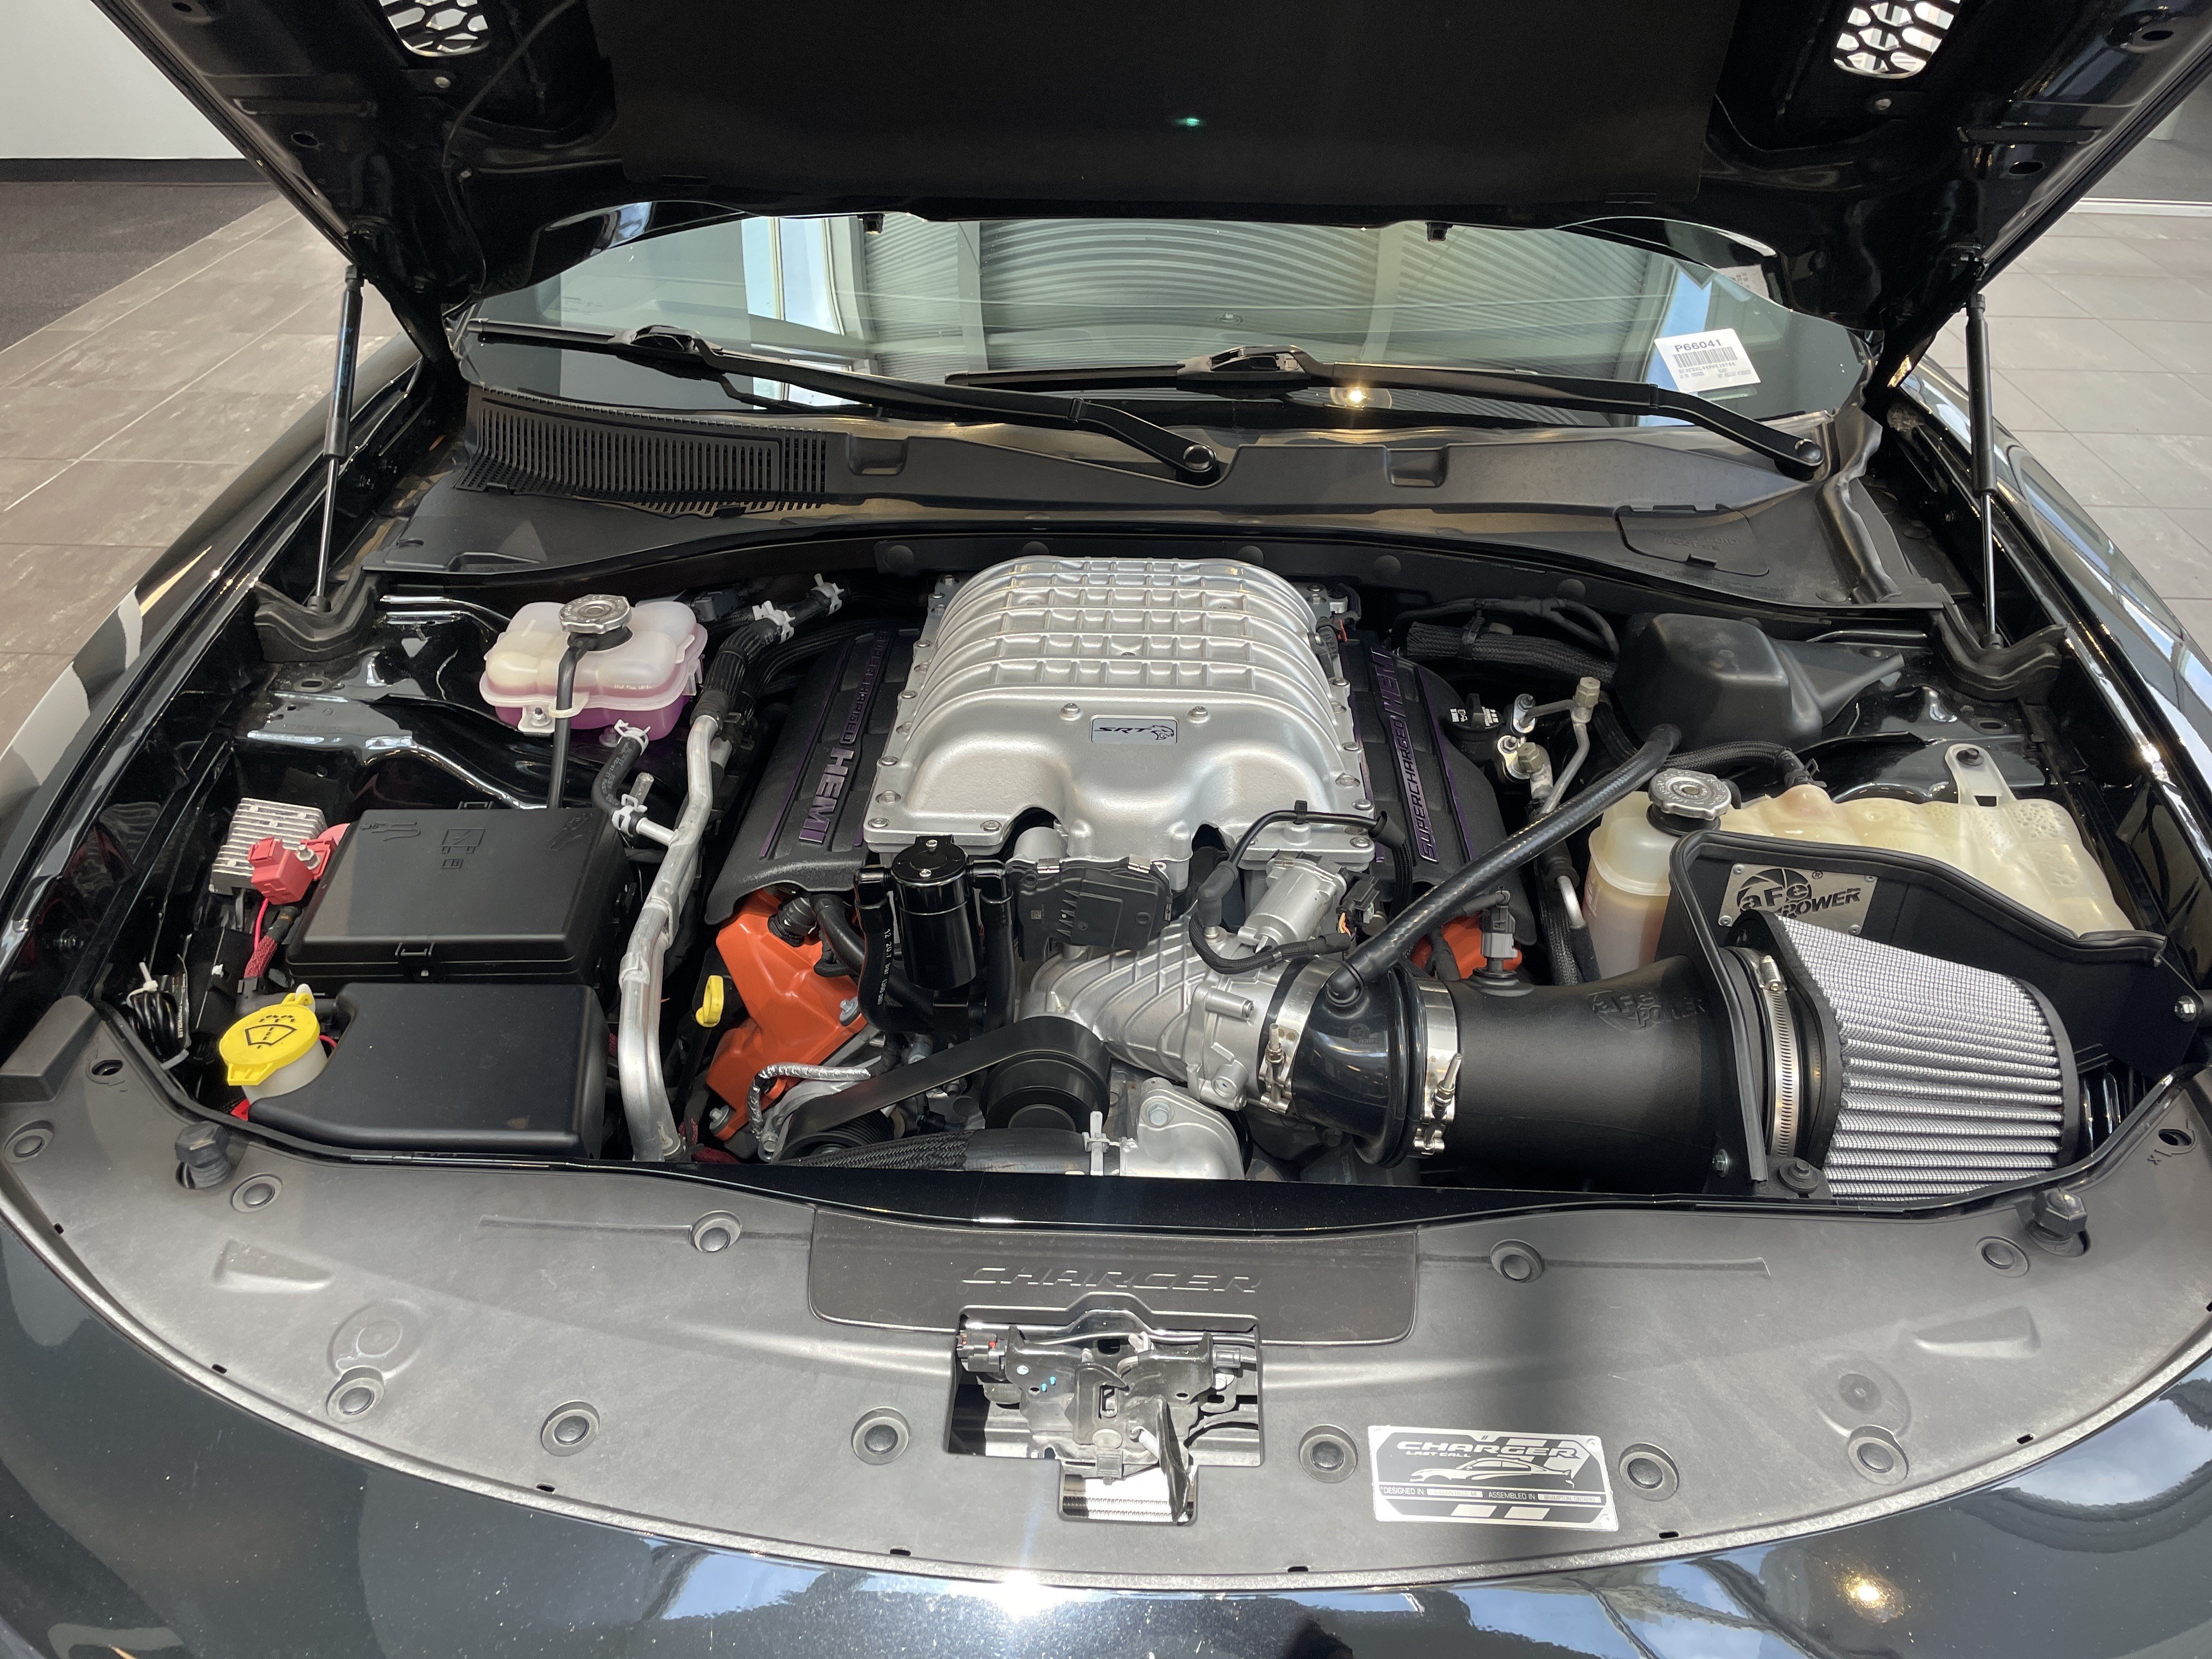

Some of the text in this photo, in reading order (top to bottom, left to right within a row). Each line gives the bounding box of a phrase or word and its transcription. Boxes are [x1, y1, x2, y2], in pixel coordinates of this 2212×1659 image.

[1674, 339, 1722, 352] P66041
[1370, 647, 1406, 717] HEMI
[799, 747, 854, 844] HEMI
[1393, 719, 1437, 860] SUPERCHARGED
[1775, 887, 1861, 919] POWER
[961, 1267, 1262, 1293] CHARGER
[1397, 1440, 1581, 1459] CHARGER
